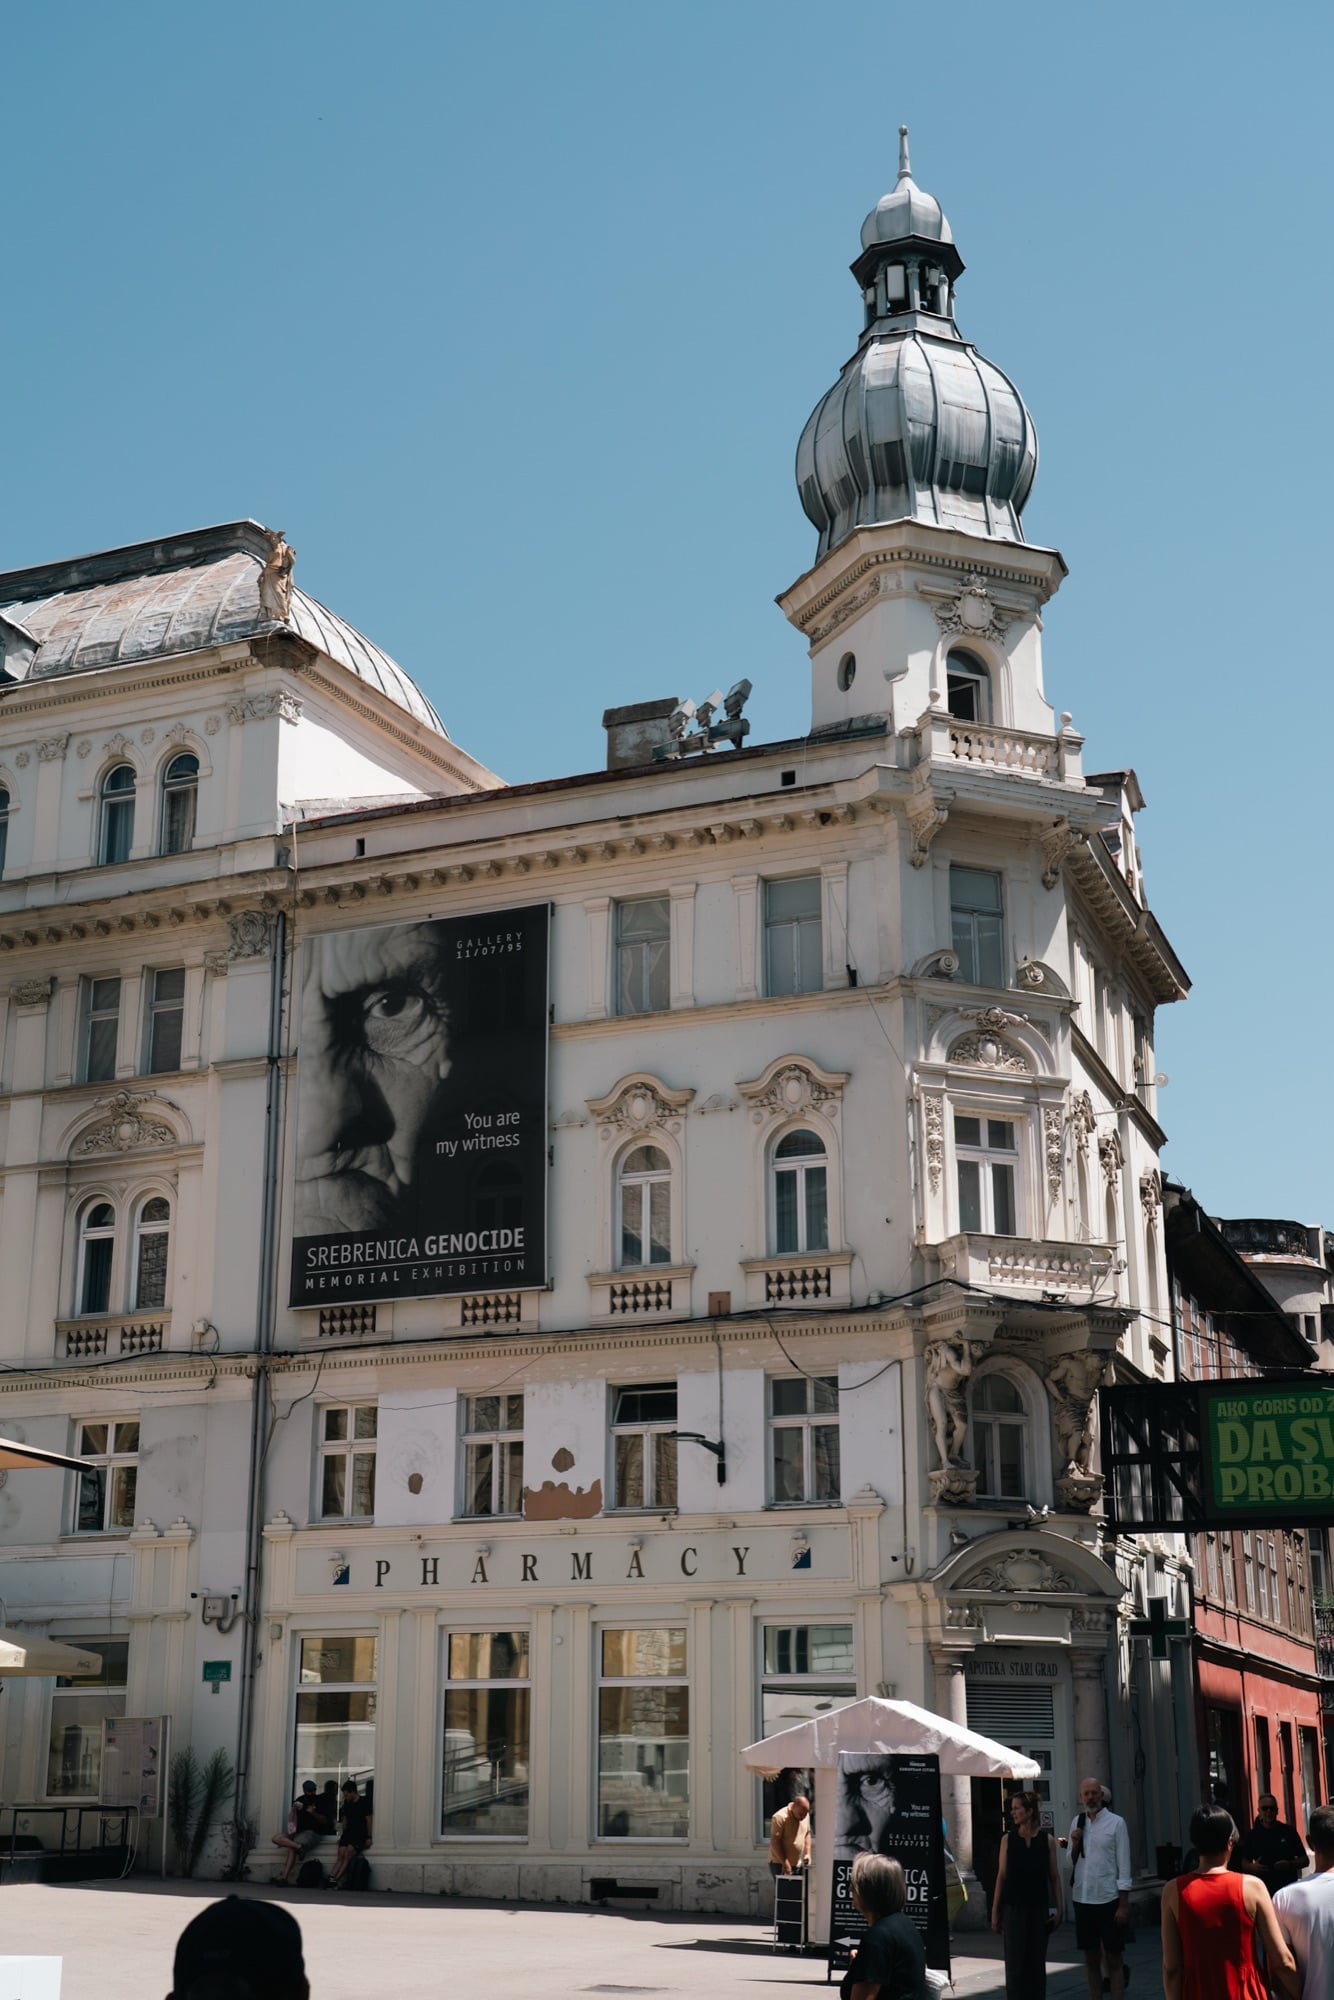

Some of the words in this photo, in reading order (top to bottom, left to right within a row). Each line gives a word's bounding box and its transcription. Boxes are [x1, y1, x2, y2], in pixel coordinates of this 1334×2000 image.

[456, 942, 522, 959] 11/07/95
[457, 932, 523, 949] GALLERY
[465, 1113, 492, 1130] You
[496, 1111, 520, 1126] are
[436, 1138, 459, 1157] my
[462, 1133, 520, 1153] witness
[306, 1238, 420, 1267] SREBRENICA
[424, 1228, 525, 1256] GENOCIDE
[305, 1270, 400, 1289] MEMORIAL
[412, 1259, 526, 1280] EXHIBITION
[1217, 1401, 1248, 1417] AKO
[1301, 1397, 1323, 1413] OD
[1218, 1420, 1284, 1463] DA
[1220, 1464, 1334, 1502] PROB
[375, 1546, 750, 1587] PHARMACY
[968, 1661, 1006, 1676] APOTEKA
[1009, 1662, 1033, 1677] STARI
[1035, 1663, 1058, 1677] GRAD
